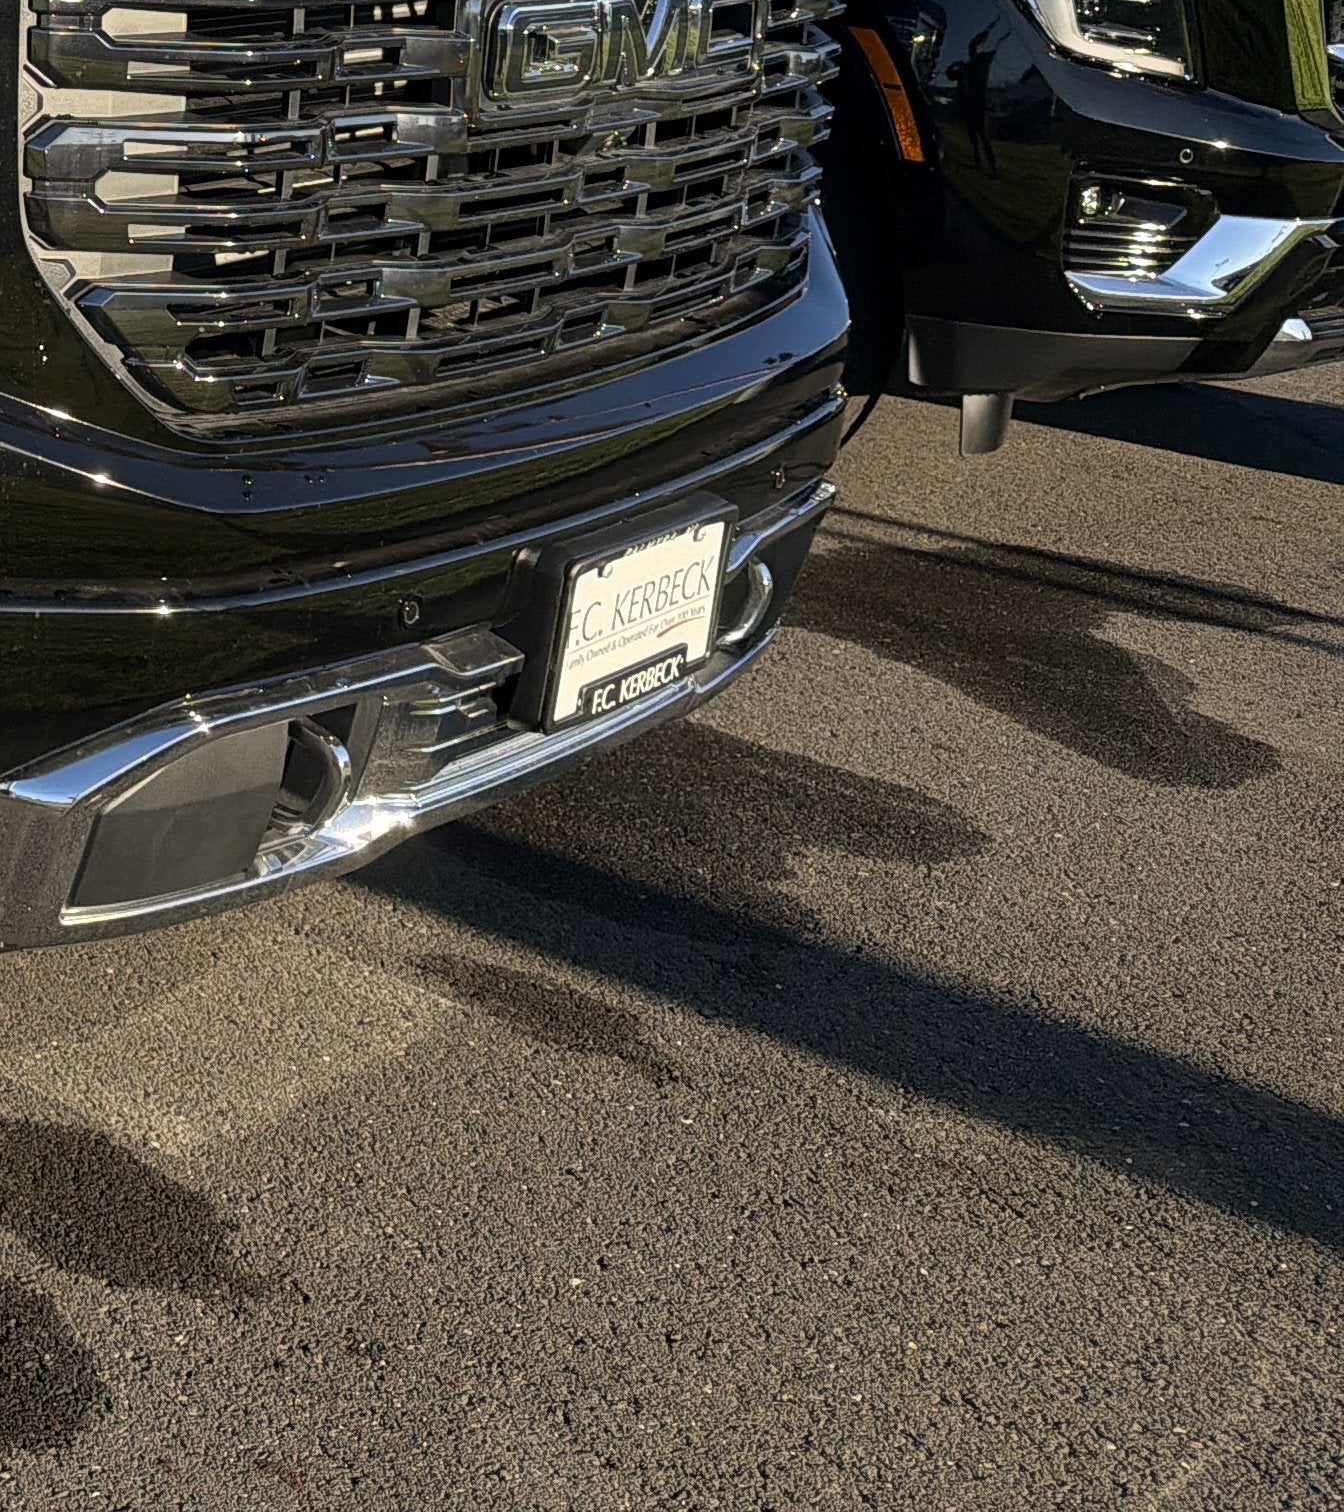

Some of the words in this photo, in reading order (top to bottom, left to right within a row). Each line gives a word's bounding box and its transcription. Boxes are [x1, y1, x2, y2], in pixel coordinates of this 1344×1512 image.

[611, 556, 715, 632] KERBECK
[591, 684, 616, 715] F.C.
[619, 654, 681, 704] KERBECK
